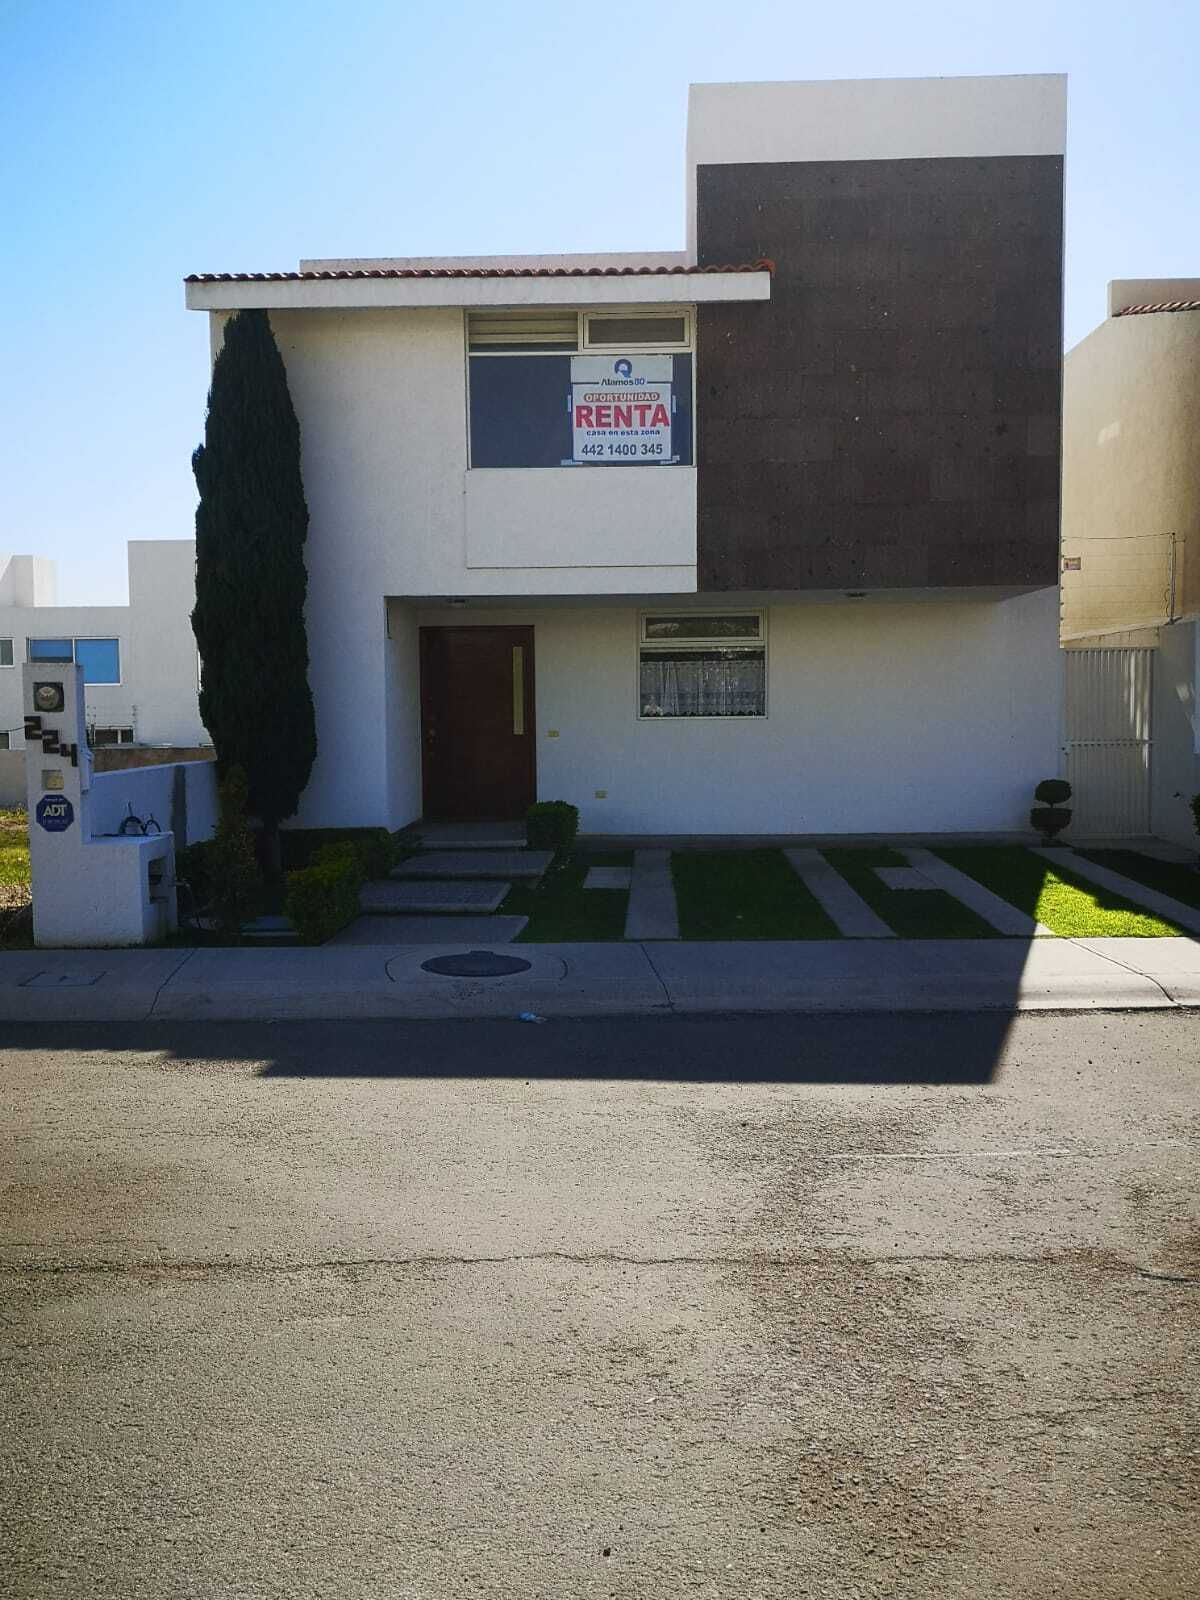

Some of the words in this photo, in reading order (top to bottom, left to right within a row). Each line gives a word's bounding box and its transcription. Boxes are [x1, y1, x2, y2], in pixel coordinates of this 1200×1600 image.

[585, 392, 659, 401] OPORTUNIDAD
[576, 404, 670, 428] RENTA
[582, 444, 604, 455] 442
[608, 444, 637, 455] 1400
[641, 443, 663, 455] 345
[24, 716, 78, 767] 224
[43, 804, 67, 817] ADT
